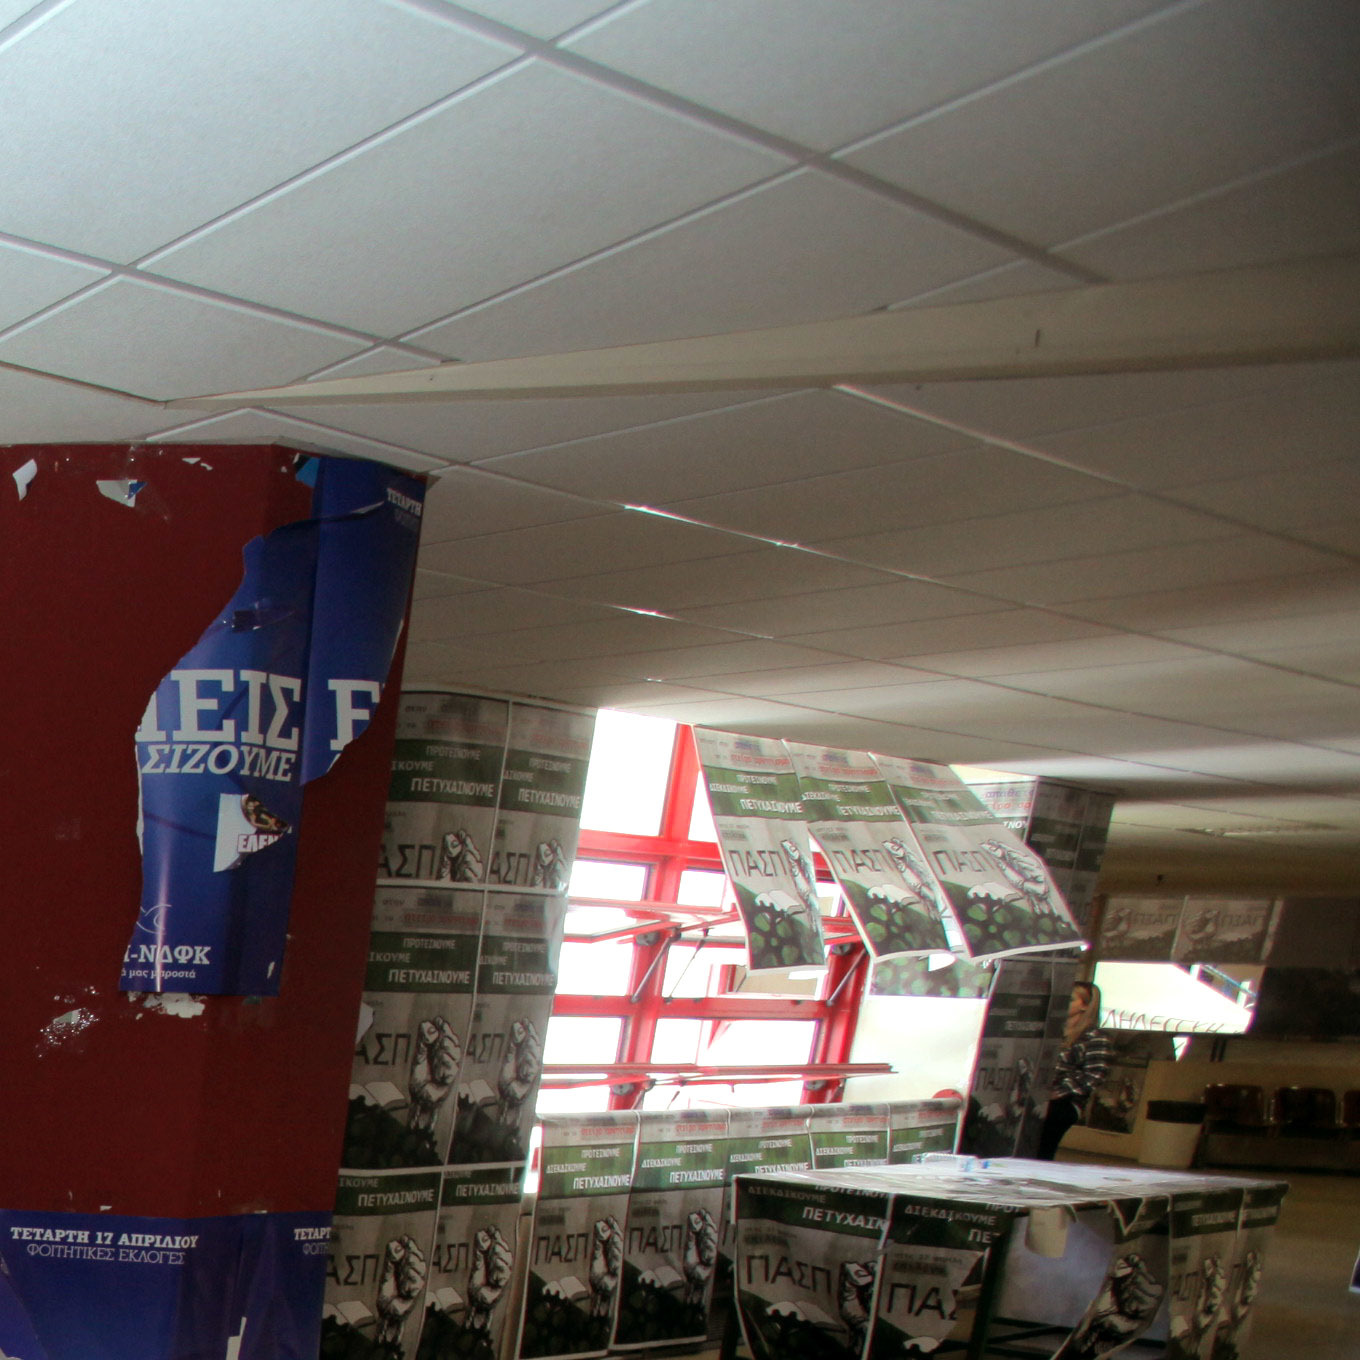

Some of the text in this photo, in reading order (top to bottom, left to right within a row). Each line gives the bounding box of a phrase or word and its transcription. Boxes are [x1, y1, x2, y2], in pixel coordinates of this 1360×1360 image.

[141, 743, 297, 782] ΣΙΖΟΥΜΕ
[411, 778, 494, 797] ΠΕΤΥΧΑΙΝΟΥΜΕ
[728, 850, 789, 877] ΠΑΣΠ
[832, 850, 893, 874] ΠΑΣΠ
[388, 969, 470, 984] ΠΕΤΥΧΑΙΝΟΥΜΕ
[573, 1174, 630, 1189] ΠΕΤΥΧΑΙΝΟΥΜΕ
[670, 1169, 723, 1183] ΠΕΤΥΧΑΙΝΟΥΜΕ
[358, 1189, 434, 1207] ΠΕΤΥΧΑΙΝΟΥΜΕ
[748, 1185, 826, 1203] ΔΙΕΚΔΙΚΟΥΜΕ
[905, 1205, 997, 1225] ΔΙΕΚΔΙΚΟΥΜΕ
[11, 1226, 198, 1249] ΤΕΤΑΡΤΗ 17 ΑΠΡΙΛΙΟΥ
[629, 1225, 683, 1254] ΠΑΣΠ
[27, 1244, 186, 1265] ΦΟΙΤΗΤΙΚΕΣ ΕΚΛΟΓΕΣ
[535, 1233, 589, 1265] ΠΑΣΠ
[746, 1255, 831, 1294] ΠΑΣΠ
